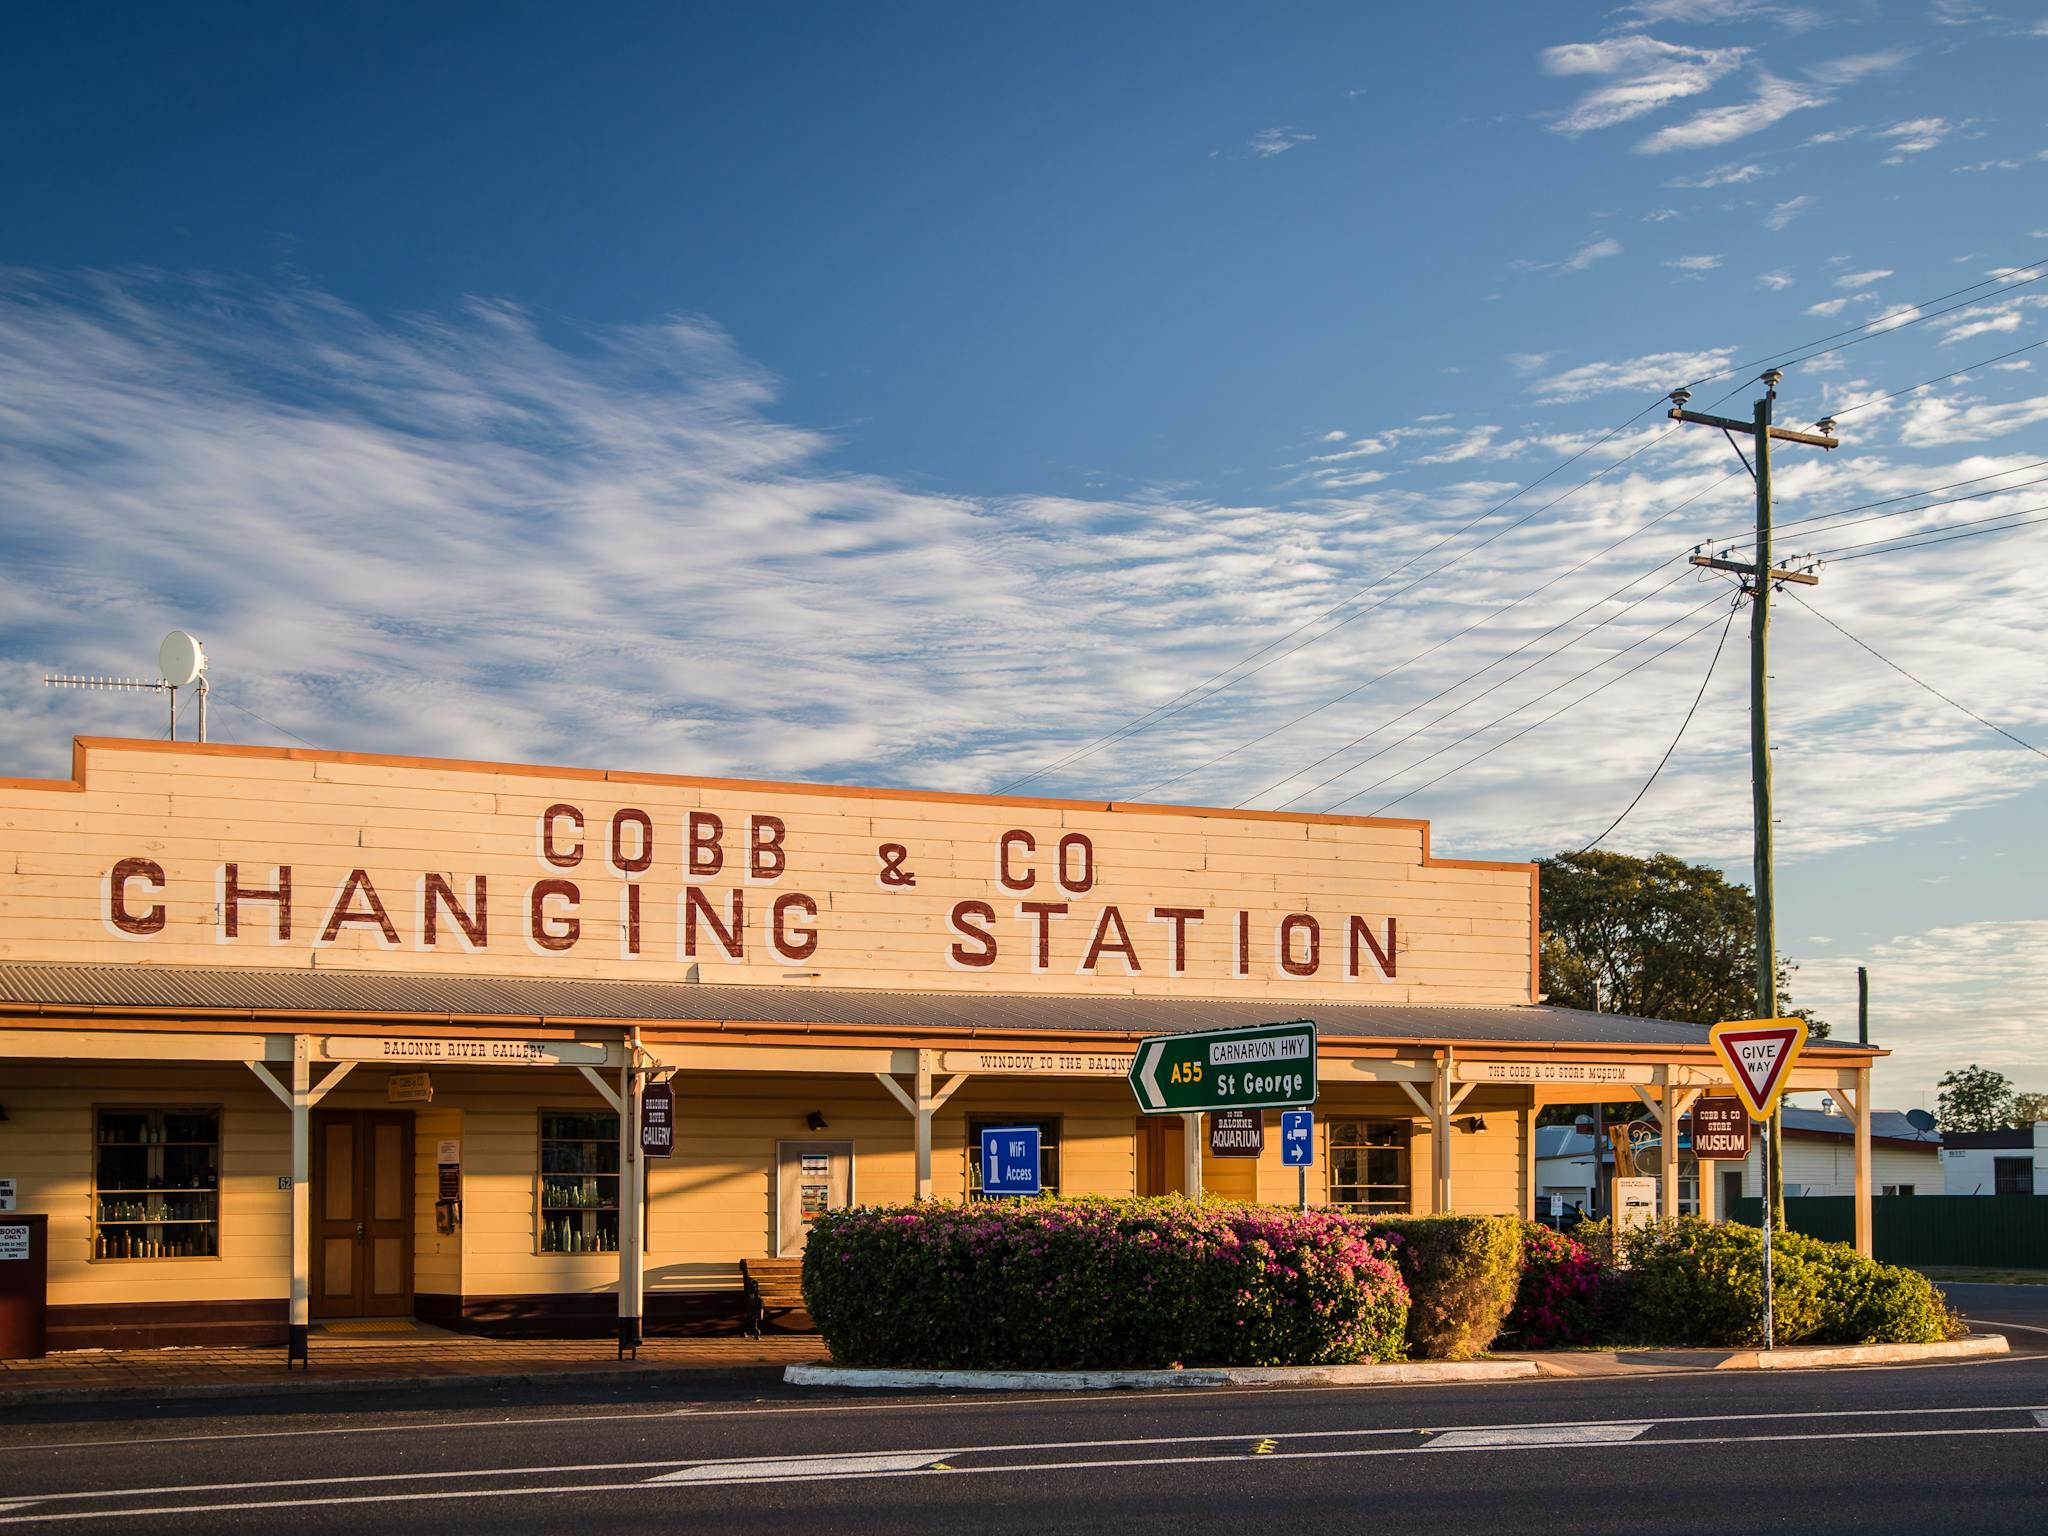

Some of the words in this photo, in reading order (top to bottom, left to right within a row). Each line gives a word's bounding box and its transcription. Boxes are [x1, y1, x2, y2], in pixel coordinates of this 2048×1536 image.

[543, 804, 785, 880] COBB
[879, 843, 916, 887] &
[1001, 829, 1094, 893] CO
[110, 857, 819, 959] CHANGING
[951, 900, 1397, 979] STATION
[384, 1042, 441, 1056] BALONNE
[448, 1043, 486, 1056] RIVER
[493, 1044, 545, 1058] GALLERY
[1213, 1042, 1275, 1061] CARNARVON
[1281, 1038, 1305, 1054] HWY
[1742, 1045, 1776, 1059] GIVE
[980, 1056, 1034, 1069] WINDOW
[1040, 1057, 1053, 1069] TO
[1060, 1057, 1081, 1070] THE
[1088, 1058, 1134, 1070] BALONN
[1748, 1061, 1771, 1073] WAY
[1171, 1062, 1203, 1083] A55
[1489, 1066, 1505, 1077] THE
[1509, 1066, 1531, 1077] COBB
[1535, 1066, 1541, 1078] &
[1545, 1067, 1555, 1078] CO
[1559, 1067, 1584, 1079] STORE
[1589, 1068, 1626, 1079] MUSEUM
[1217, 1074, 1235, 1096] St
[1243, 1072, 1303, 1098] George
[1700, 1111, 1718, 1120] COBB
[1721, 1111, 1727, 1119] &
[1730, 1110, 1740, 1119] CO
[1218, 1119, 1252, 1128] BALONNE
[1708, 1122, 1731, 1131] STORE
[643, 1126, 671, 1145] GALLERY
[1212, 1131, 1260, 1147] AQUARIUM
[1696, 1134, 1745, 1151] MUSEUM
[1009, 1141, 1025, 1157] WiFi
[1006, 1165, 1032, 1180] Access
